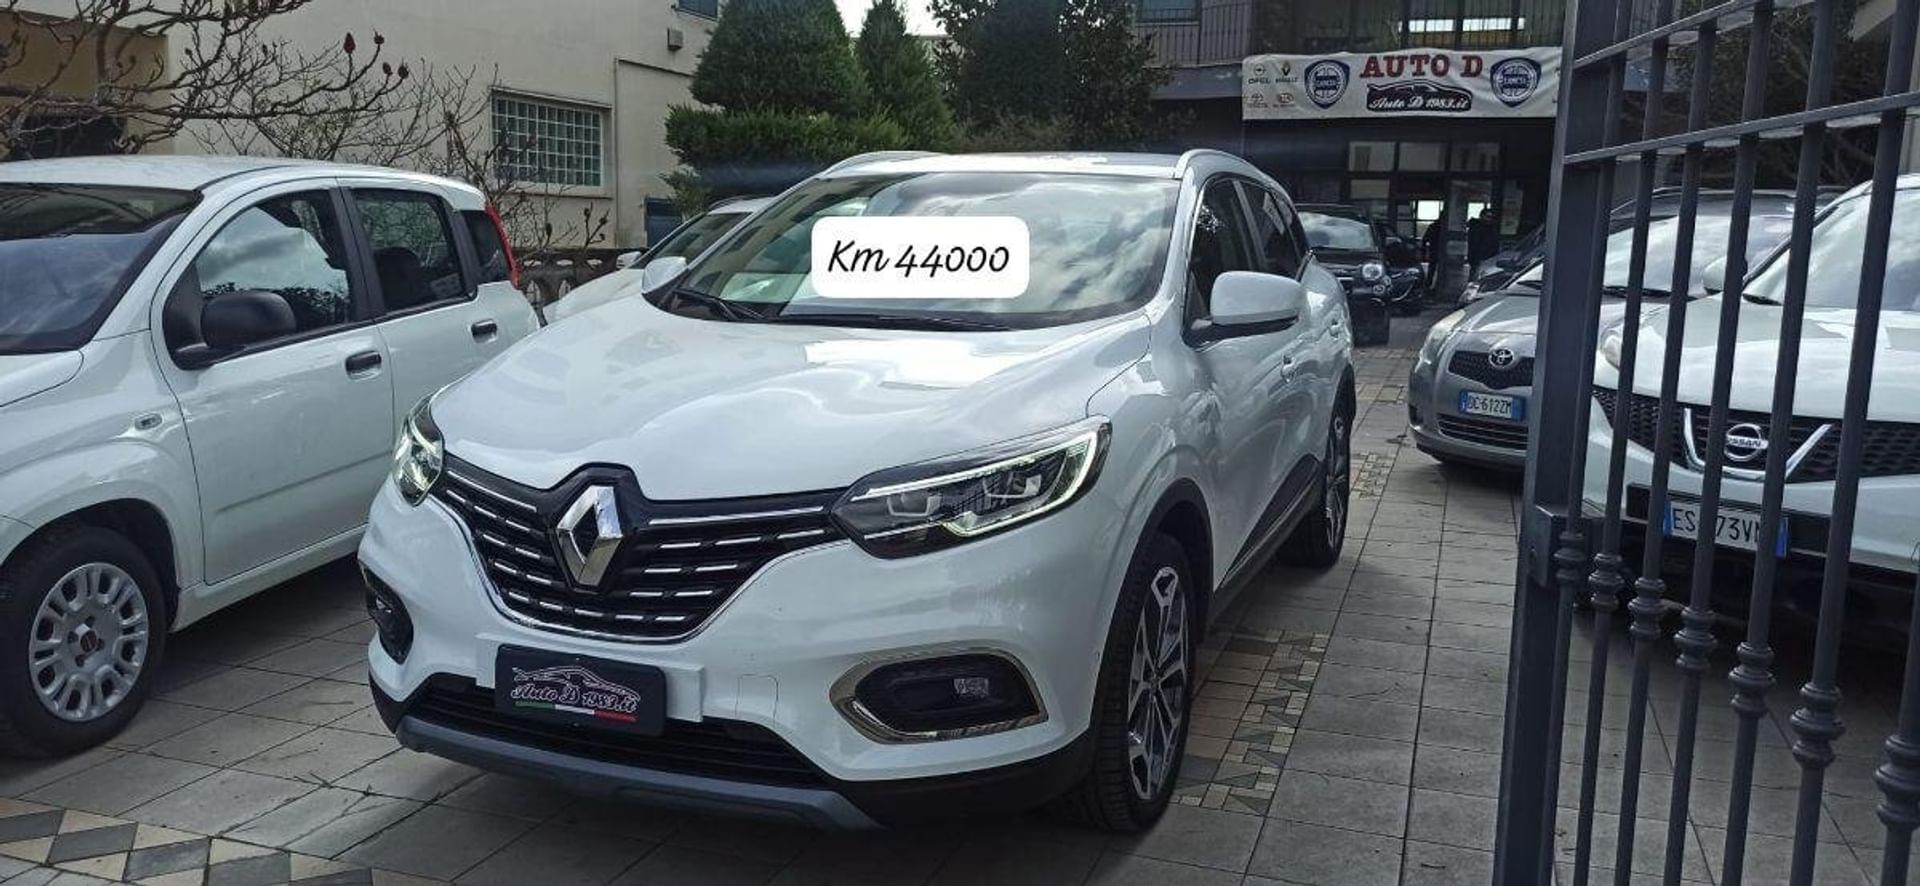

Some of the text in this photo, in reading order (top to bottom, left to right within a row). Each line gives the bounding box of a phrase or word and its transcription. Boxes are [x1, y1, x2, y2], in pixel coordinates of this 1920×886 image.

[1360, 54, 1483, 78] AUTO D
[1368, 97, 1405, 109] Auto
[1672, 508, 1760, 543] ES73V
[511, 683, 558, 701] Auto
